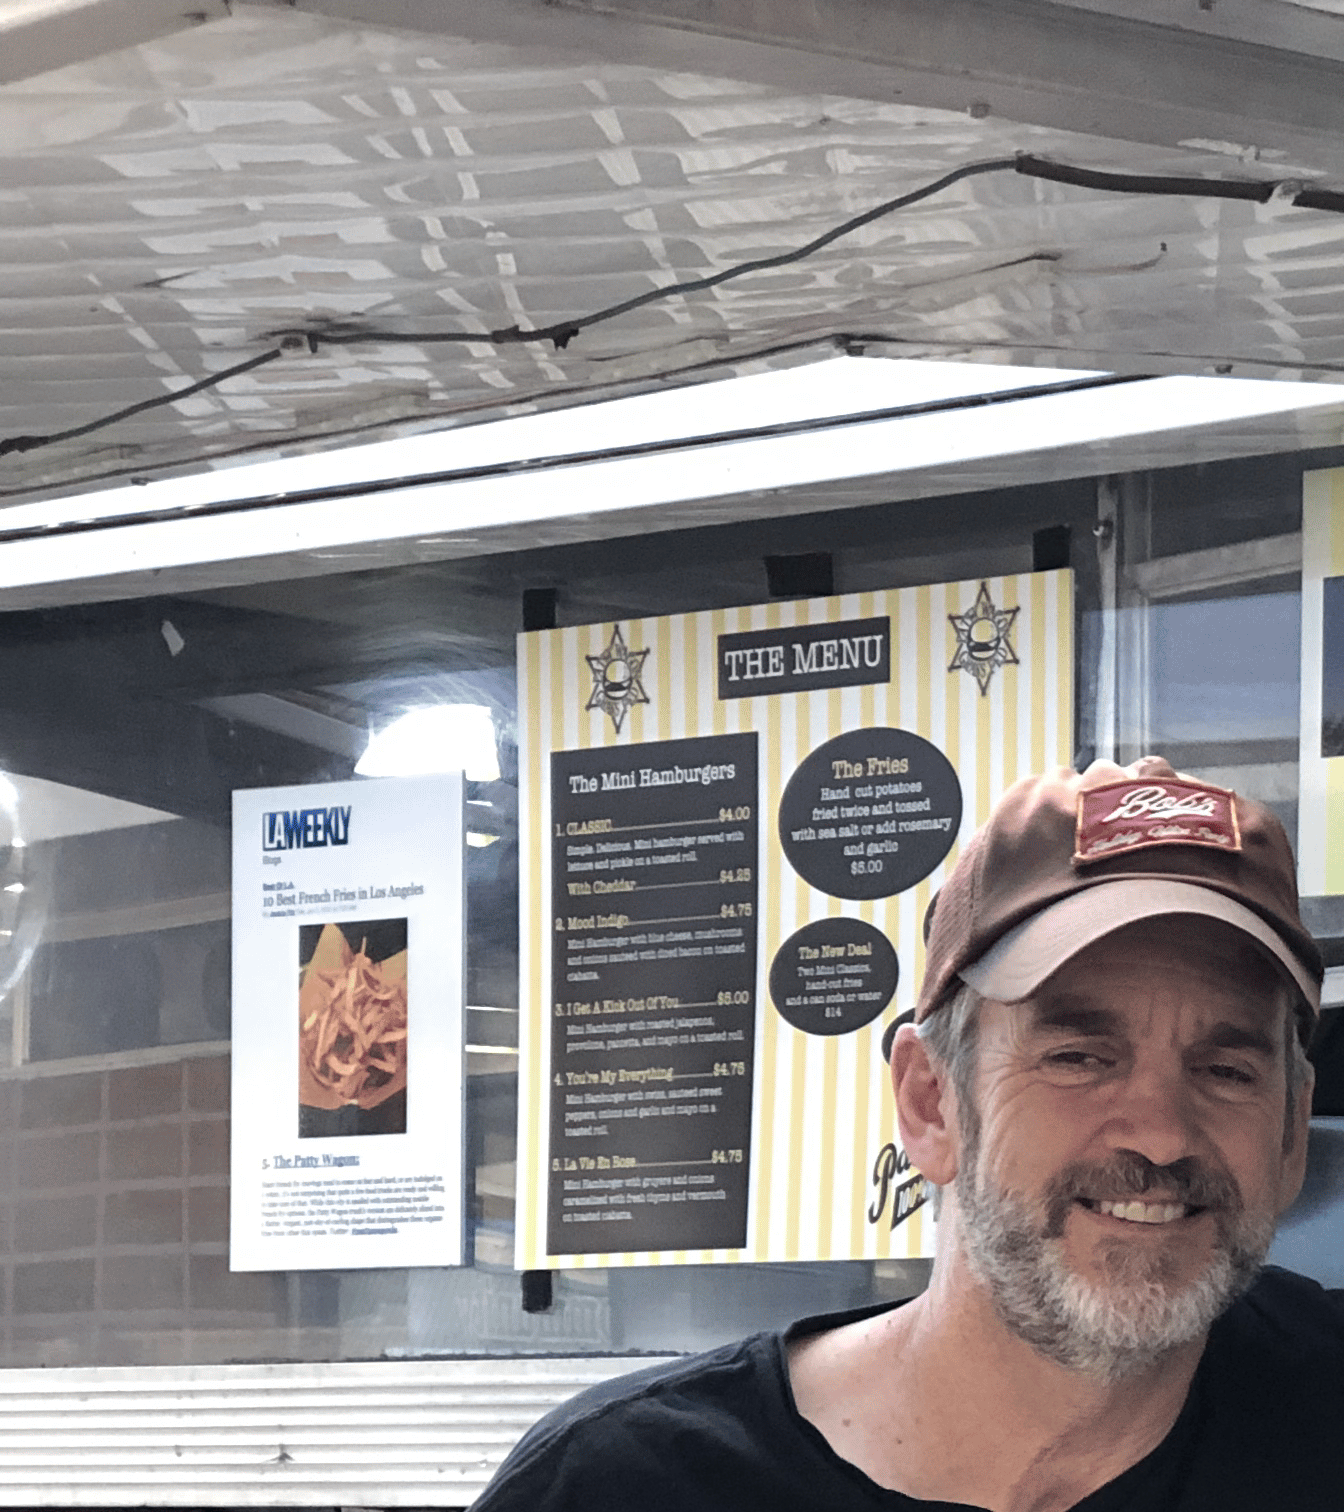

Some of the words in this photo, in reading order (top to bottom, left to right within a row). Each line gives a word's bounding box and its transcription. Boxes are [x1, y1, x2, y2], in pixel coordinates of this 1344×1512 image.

[725, 648, 784, 682] THE
[792, 634, 884, 675] MENU
[569, 776, 598, 794] The
[601, 771, 636, 790] Mini
[639, 764, 736, 787] Hamburgers
[832, 760, 863, 780] The
[867, 757, 909, 776] Fries
[820, 787, 850, 801] Hand
[855, 785, 873, 798] cut
[875, 781, 922, 798] potatoes
[718, 806, 750, 822] $4.00
[812, 806, 839, 821] fried
[840, 803, 870, 818] twice
[872, 801, 893, 815] and
[895, 798, 931, 813] tossed
[1101, 786, 1218, 822] Bob's
[791, 826, 816, 842] with
[818, 826, 837, 839] sea
[838, 823, 859, 838] salt
[861, 823, 873, 835] or
[876, 820, 897, 835] add
[898, 816, 952, 832] rosemary
[843, 842, 865, 857] and
[867, 840, 899, 857] garlic
[850, 860, 883, 875] $5.00
[276, 893, 296, 906] Best
[299, 888, 331, 905] French
[333, 887, 356, 902] Fries
[358, 887, 368, 900] in
[370, 885, 386, 899] Los
[387, 882, 424, 900] Angeles
[567, 881, 592, 895] With
[593, 878, 636, 894] Cheddar
[567, 916, 595, 930] Mood
[720, 903, 752, 918] $4.75
[798, 946, 819, 960] The
[821, 944, 845, 958] New
[847, 942, 872, 957] Deal
[555, 1003, 566, 1016] 3.
[567, 1003, 573, 1016] I
[574, 1001, 590, 1015] Get
[592, 1001, 602, 1014] A
[604, 998, 627, 1013] Kick
[628, 999, 646, 1012] Out
[647, 997, 659, 1011] Of
[659, 997, 679, 1010] You
[825, 1007, 842, 1018] $14
[554, 1073, 564, 1086] 4.
[566, 1071, 599, 1086] You're
[600, 1070, 617, 1086] My
[619, 1068, 674, 1084] Everything
[713, 1062, 745, 1077] $4.75
[273, 1155, 291, 1169] The
[294, 1154, 319, 1169] Patty
[552, 1158, 562, 1171] 5.
[564, 1158, 577, 1170] La
[579, 1157, 595, 1170] Vie
[597, 1157, 611, 1169] En
[712, 1149, 743, 1164] $4.75
